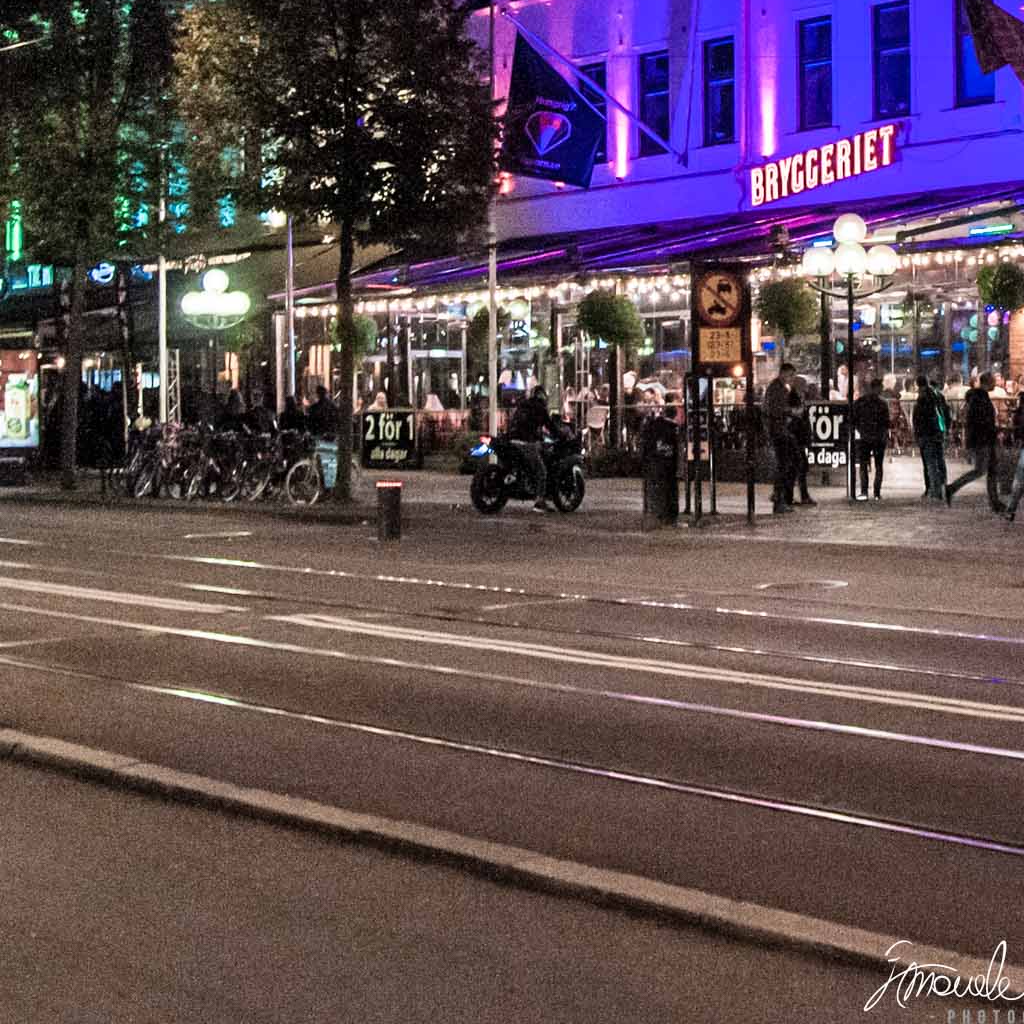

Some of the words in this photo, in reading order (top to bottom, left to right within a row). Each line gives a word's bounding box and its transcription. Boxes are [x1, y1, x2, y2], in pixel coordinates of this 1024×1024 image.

[751, 124, 894, 207] BRYGGERIET
[365, 415, 375, 441] 2
[379, 414, 402, 441] för
[407, 415, 414, 441] 1
[809, 406, 844, 441] för
[385, 448, 408, 463] dagar
